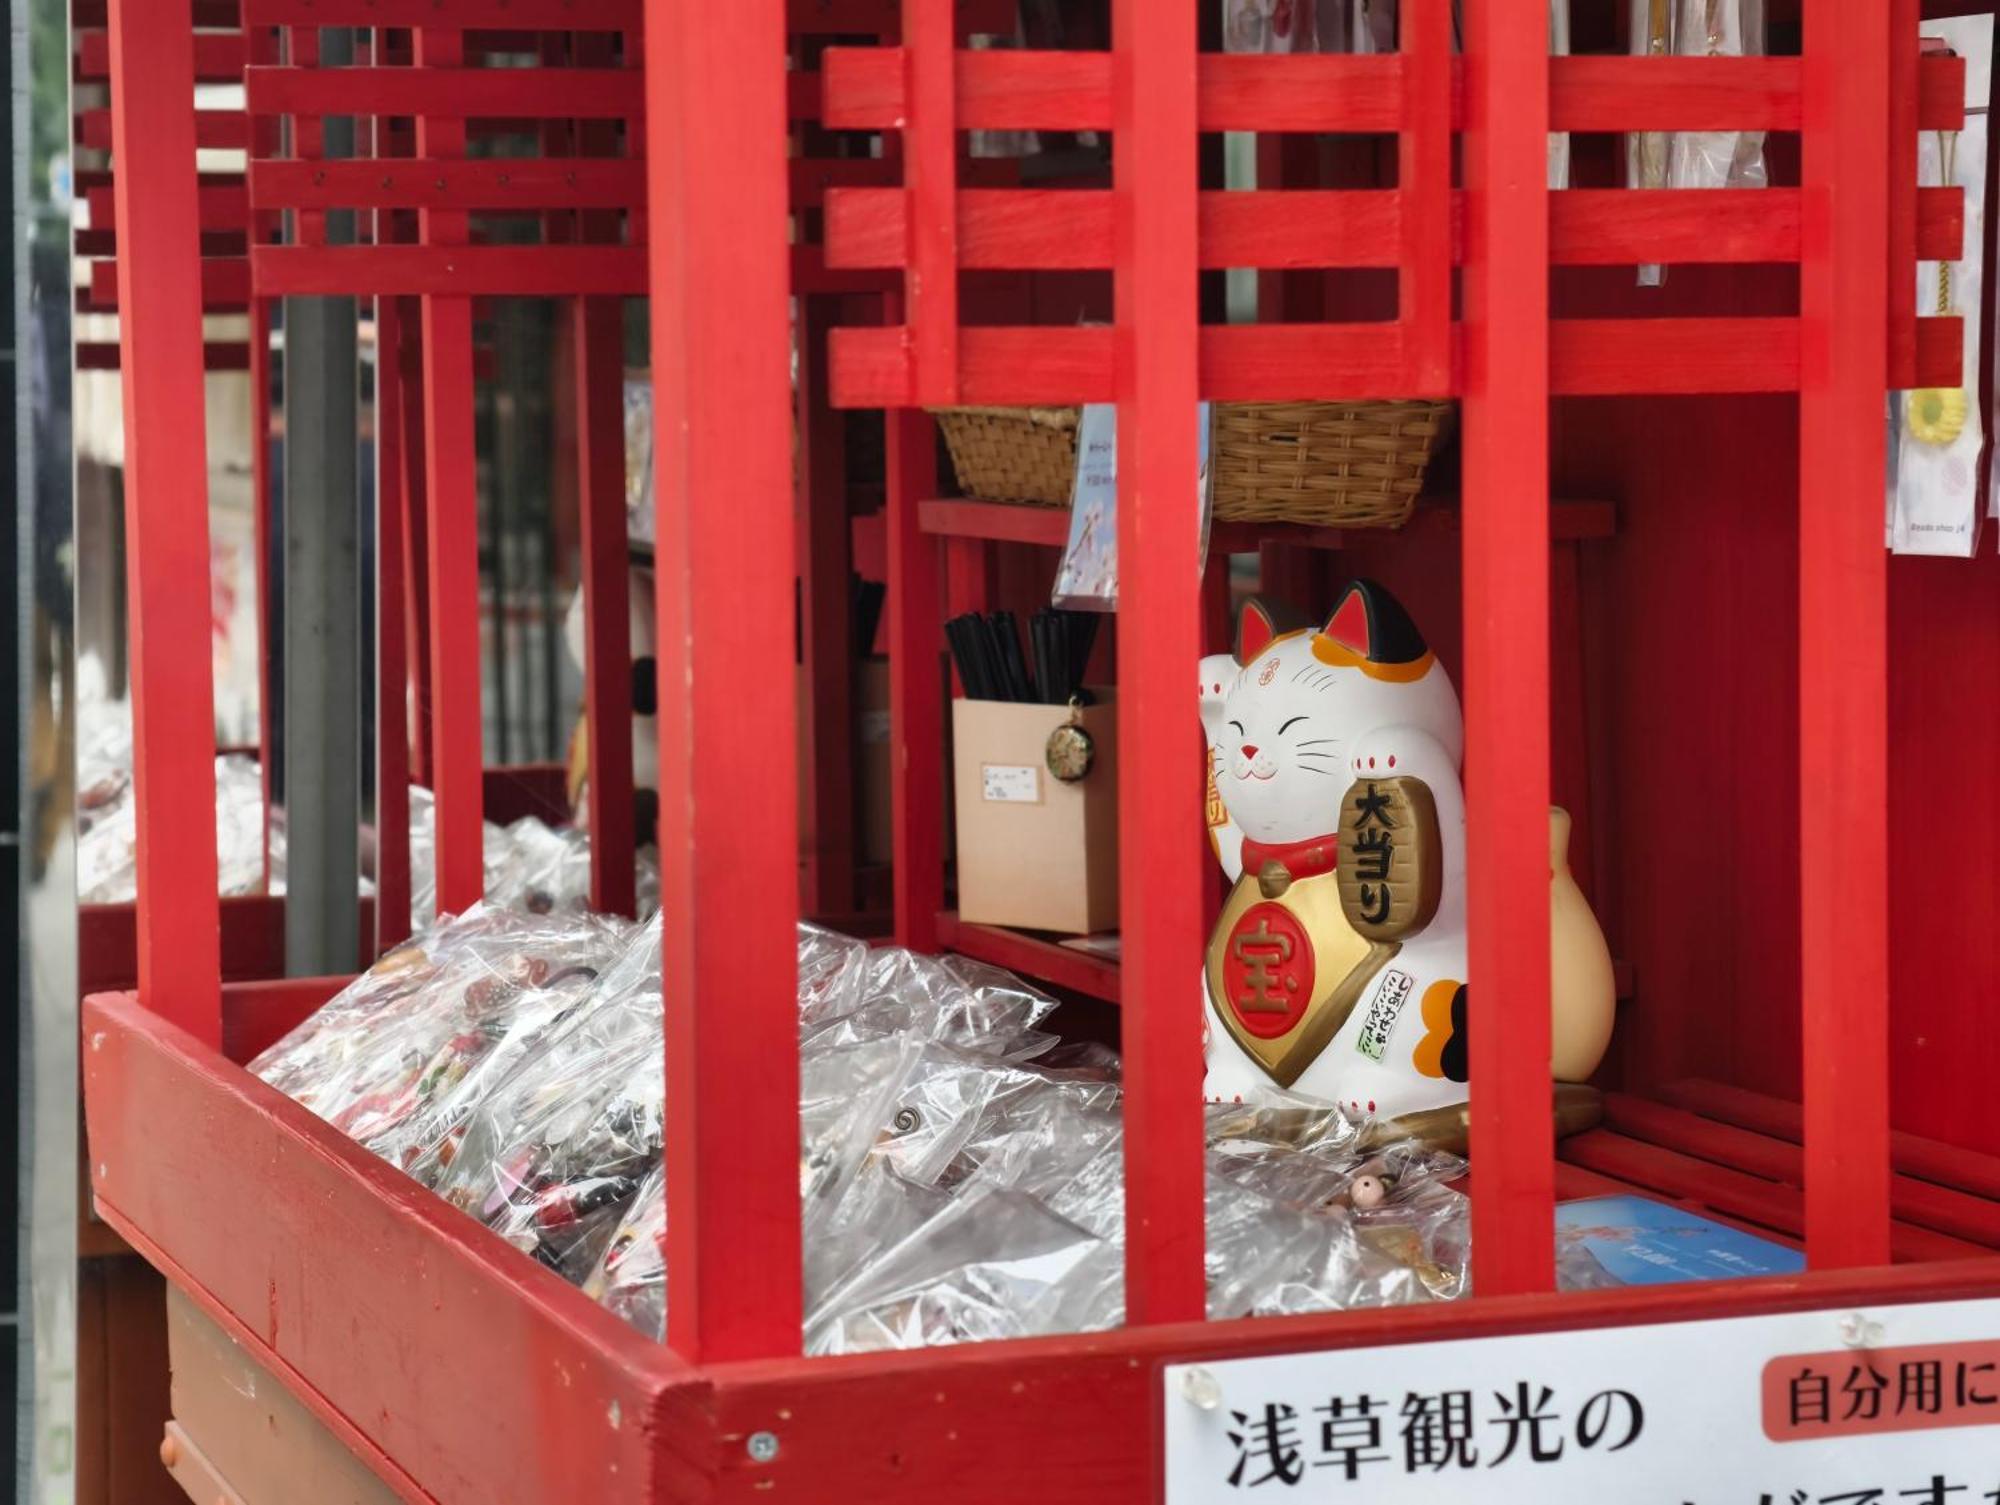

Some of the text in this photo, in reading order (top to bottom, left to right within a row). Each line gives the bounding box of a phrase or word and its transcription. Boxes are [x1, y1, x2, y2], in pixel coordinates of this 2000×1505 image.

[1353, 783, 1393, 924] 大当り
[1235, 918, 1298, 1012] 宝
[1226, 1381, 1645, 1488] 浅草観光の
[1789, 1360, 1999, 1427] 自分用に
